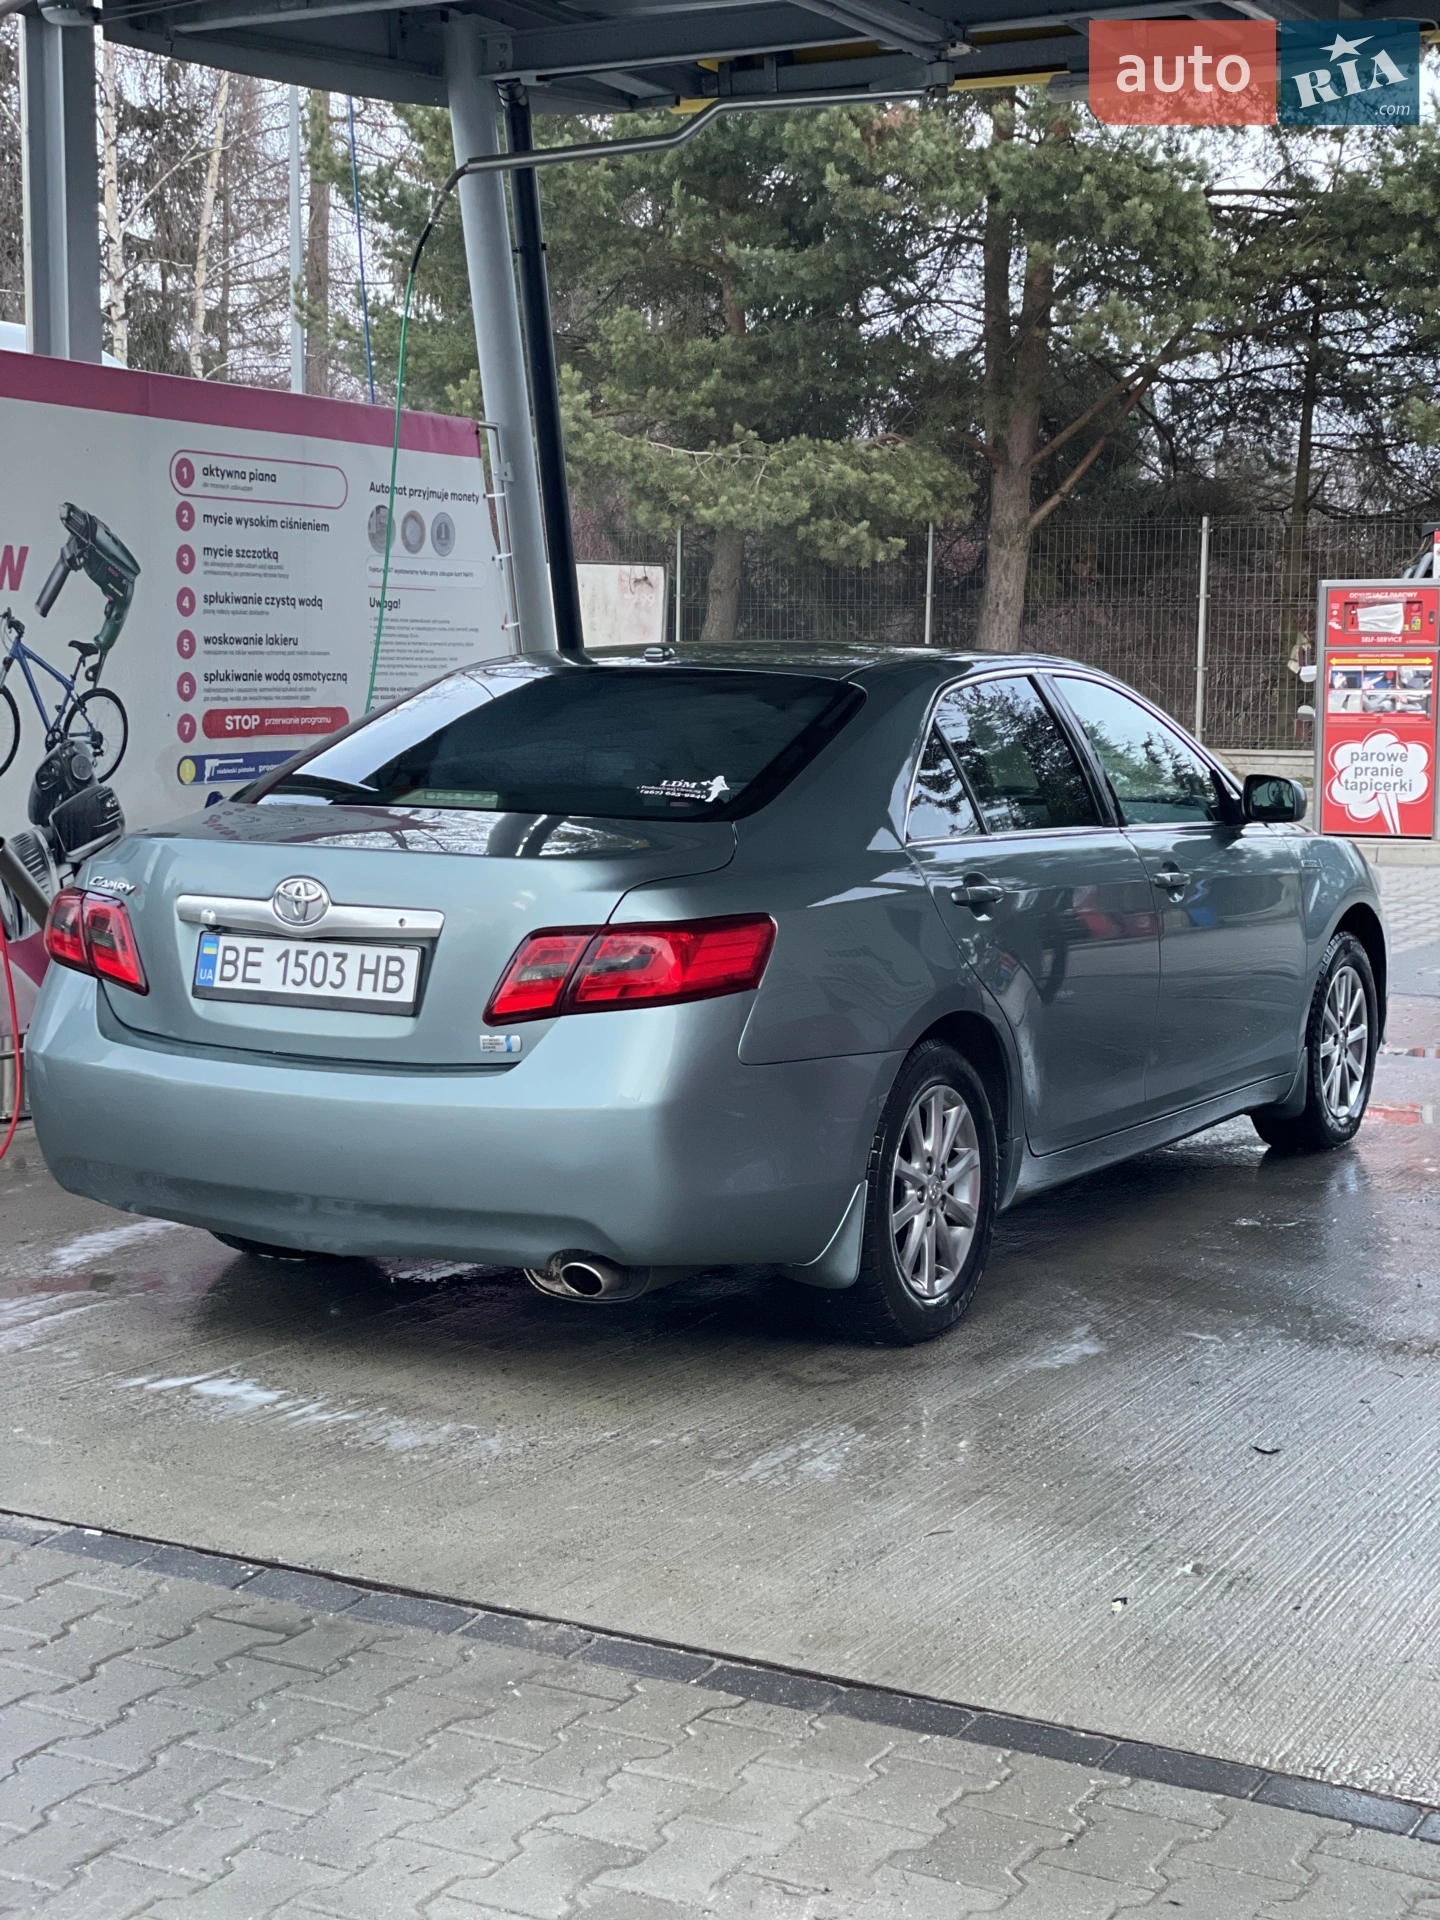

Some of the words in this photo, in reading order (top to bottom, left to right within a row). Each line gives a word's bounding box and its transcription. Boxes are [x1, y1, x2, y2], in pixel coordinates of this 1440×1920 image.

[182, 466, 188, 480] 1
[202, 464, 247, 480] aktywna
[249, 468, 277, 483] piana
[408, 486, 449, 502] przyjmuje
[450, 492, 480, 504] monety
[182, 510, 189, 522] 2
[203, 512, 233, 526] mycie
[235, 514, 278, 529] wysokim
[280, 517, 330, 532] ciśnieniem
[182, 553, 190, 566] 3
[203, 545, 234, 559] mycie
[236, 548, 279, 563] szczotką
[182, 596, 190, 608] 4
[203, 592, 263, 606] spłukiwanie
[264, 594, 296, 609] czystą
[298, 596, 323, 610] wodą
[182, 638, 190, 652] 5
[203, 633, 264, 646] woskowanie
[265, 634, 299, 646] lakieru
[182, 681, 190, 694] 6
[204, 670, 263, 684] spłukiwanie
[265, 670, 291, 684] wodą
[292, 670, 348, 684] osmotyczną
[183, 722, 190, 734] 7
[225, 714, 260, 730] STOP
[264, 716, 300, 726] przerwanie
[300, 716, 332, 726] programu
[1350, 751, 1408, 764] parowe
[1354, 764, 1404, 779] pranie
[1344, 778, 1412, 794] tapicerki
[88, 876, 136, 896] CAMRY
[200, 968, 214, 981] UA
[218, 945, 265, 984] BE
[276, 948, 349, 990] 1503
[356, 954, 406, 994] HB
